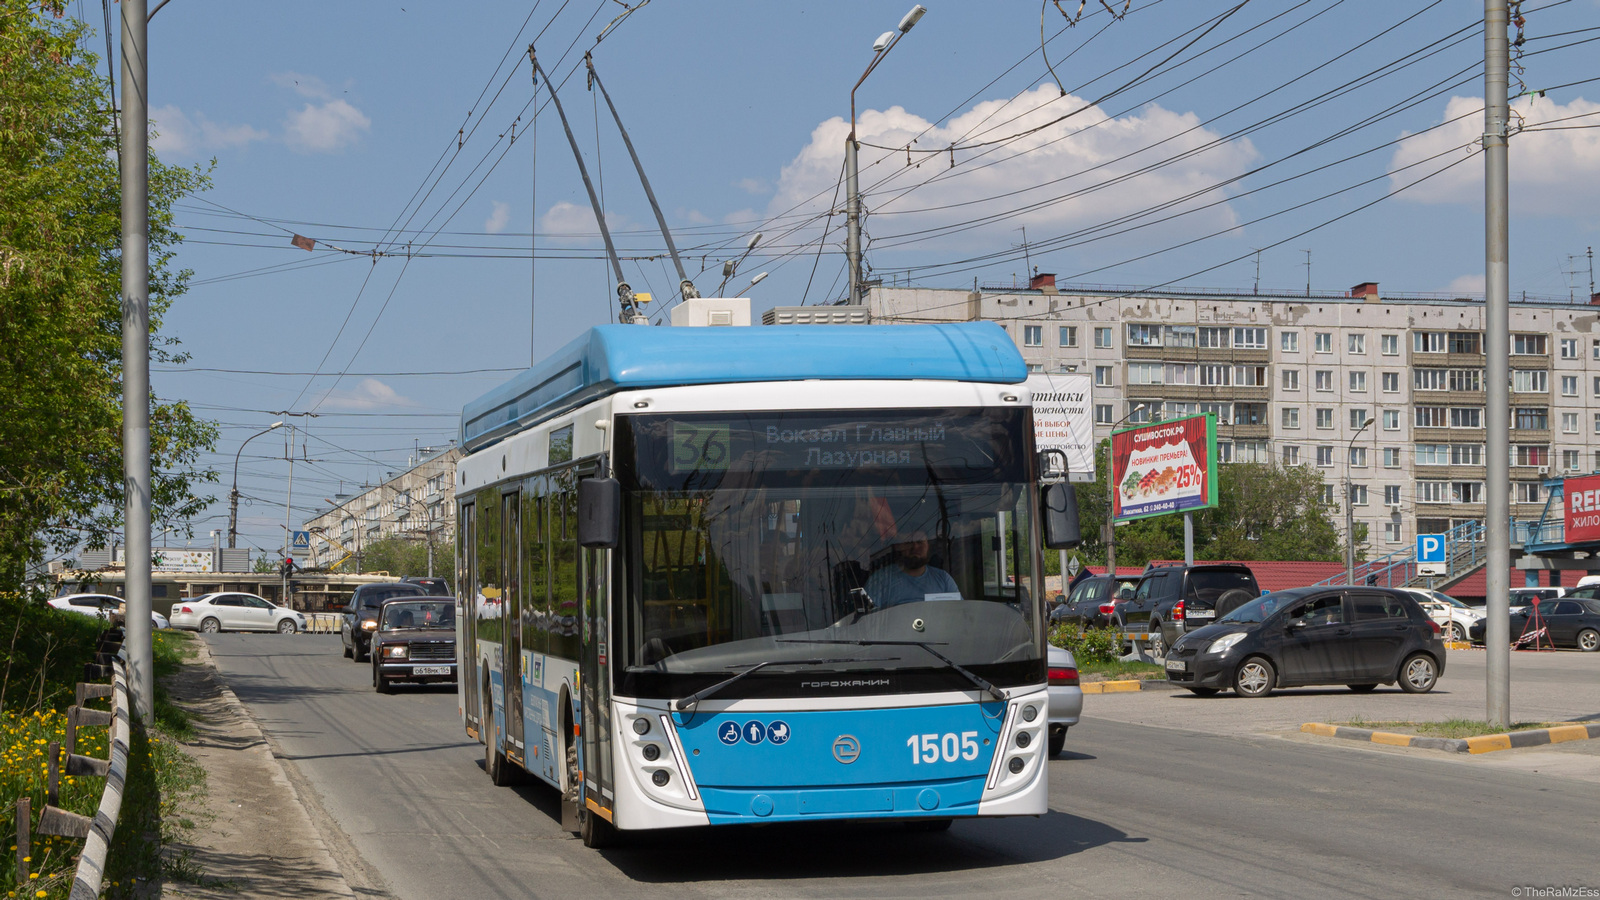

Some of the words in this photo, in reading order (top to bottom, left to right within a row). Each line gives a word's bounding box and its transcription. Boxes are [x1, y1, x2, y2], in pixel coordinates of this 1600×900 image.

[1033, 407, 1084, 415] ожности
[1045, 420, 1071, 428] ВЫБОР
[766, 425, 847, 444] Вокзал
[855, 423, 946, 442] Главный
[1133, 426, 1185, 443] СУШИВОСТОК.РФ
[675, 429, 727, 465] 36
[1036, 442, 1086, 450] ГОУСТРОЙСТВО
[803, 447, 911, 467] Лазурная
[1131, 456, 1159, 467] НОВИНКИ!
[1159, 449, 1188, 463] ПРЕМЬЕРА!
[1172, 463, 1201, 489] -25%
[1572, 514, 1600, 528] ЖИЛО
[1423, 537, 1439, 560] P
[801, 678, 890, 689] ГОРОЖАНИН
[906, 730, 979, 765] 1505
